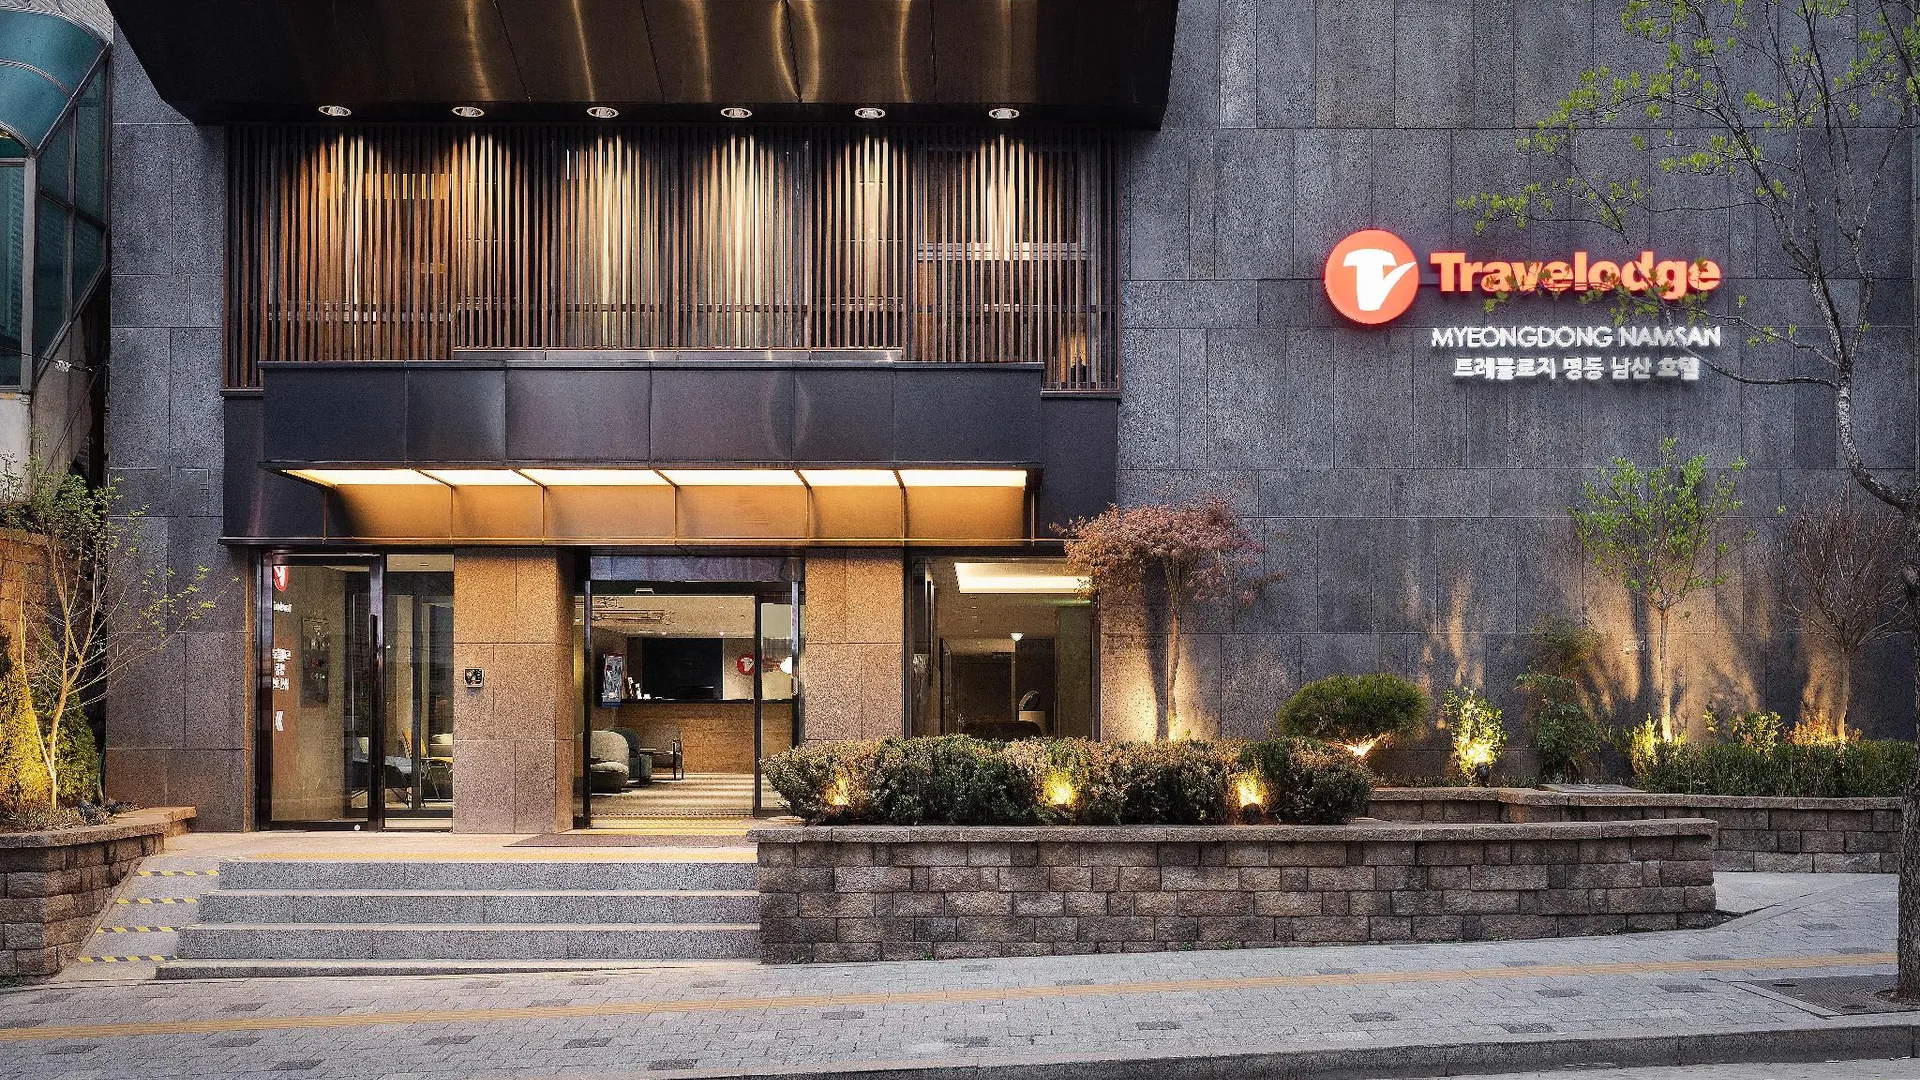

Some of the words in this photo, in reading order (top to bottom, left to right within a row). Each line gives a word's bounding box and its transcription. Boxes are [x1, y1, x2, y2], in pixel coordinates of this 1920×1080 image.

[1430, 251, 1721, 300] Travelodge
[1431, 327, 1613, 347] MYEONGDONG
[1619, 327, 1721, 347] NAMSAN
[1563, 357, 1605, 380] 명동
[1612, 357, 1652, 380] 남산
[1656, 357, 1700, 380] 호텔
